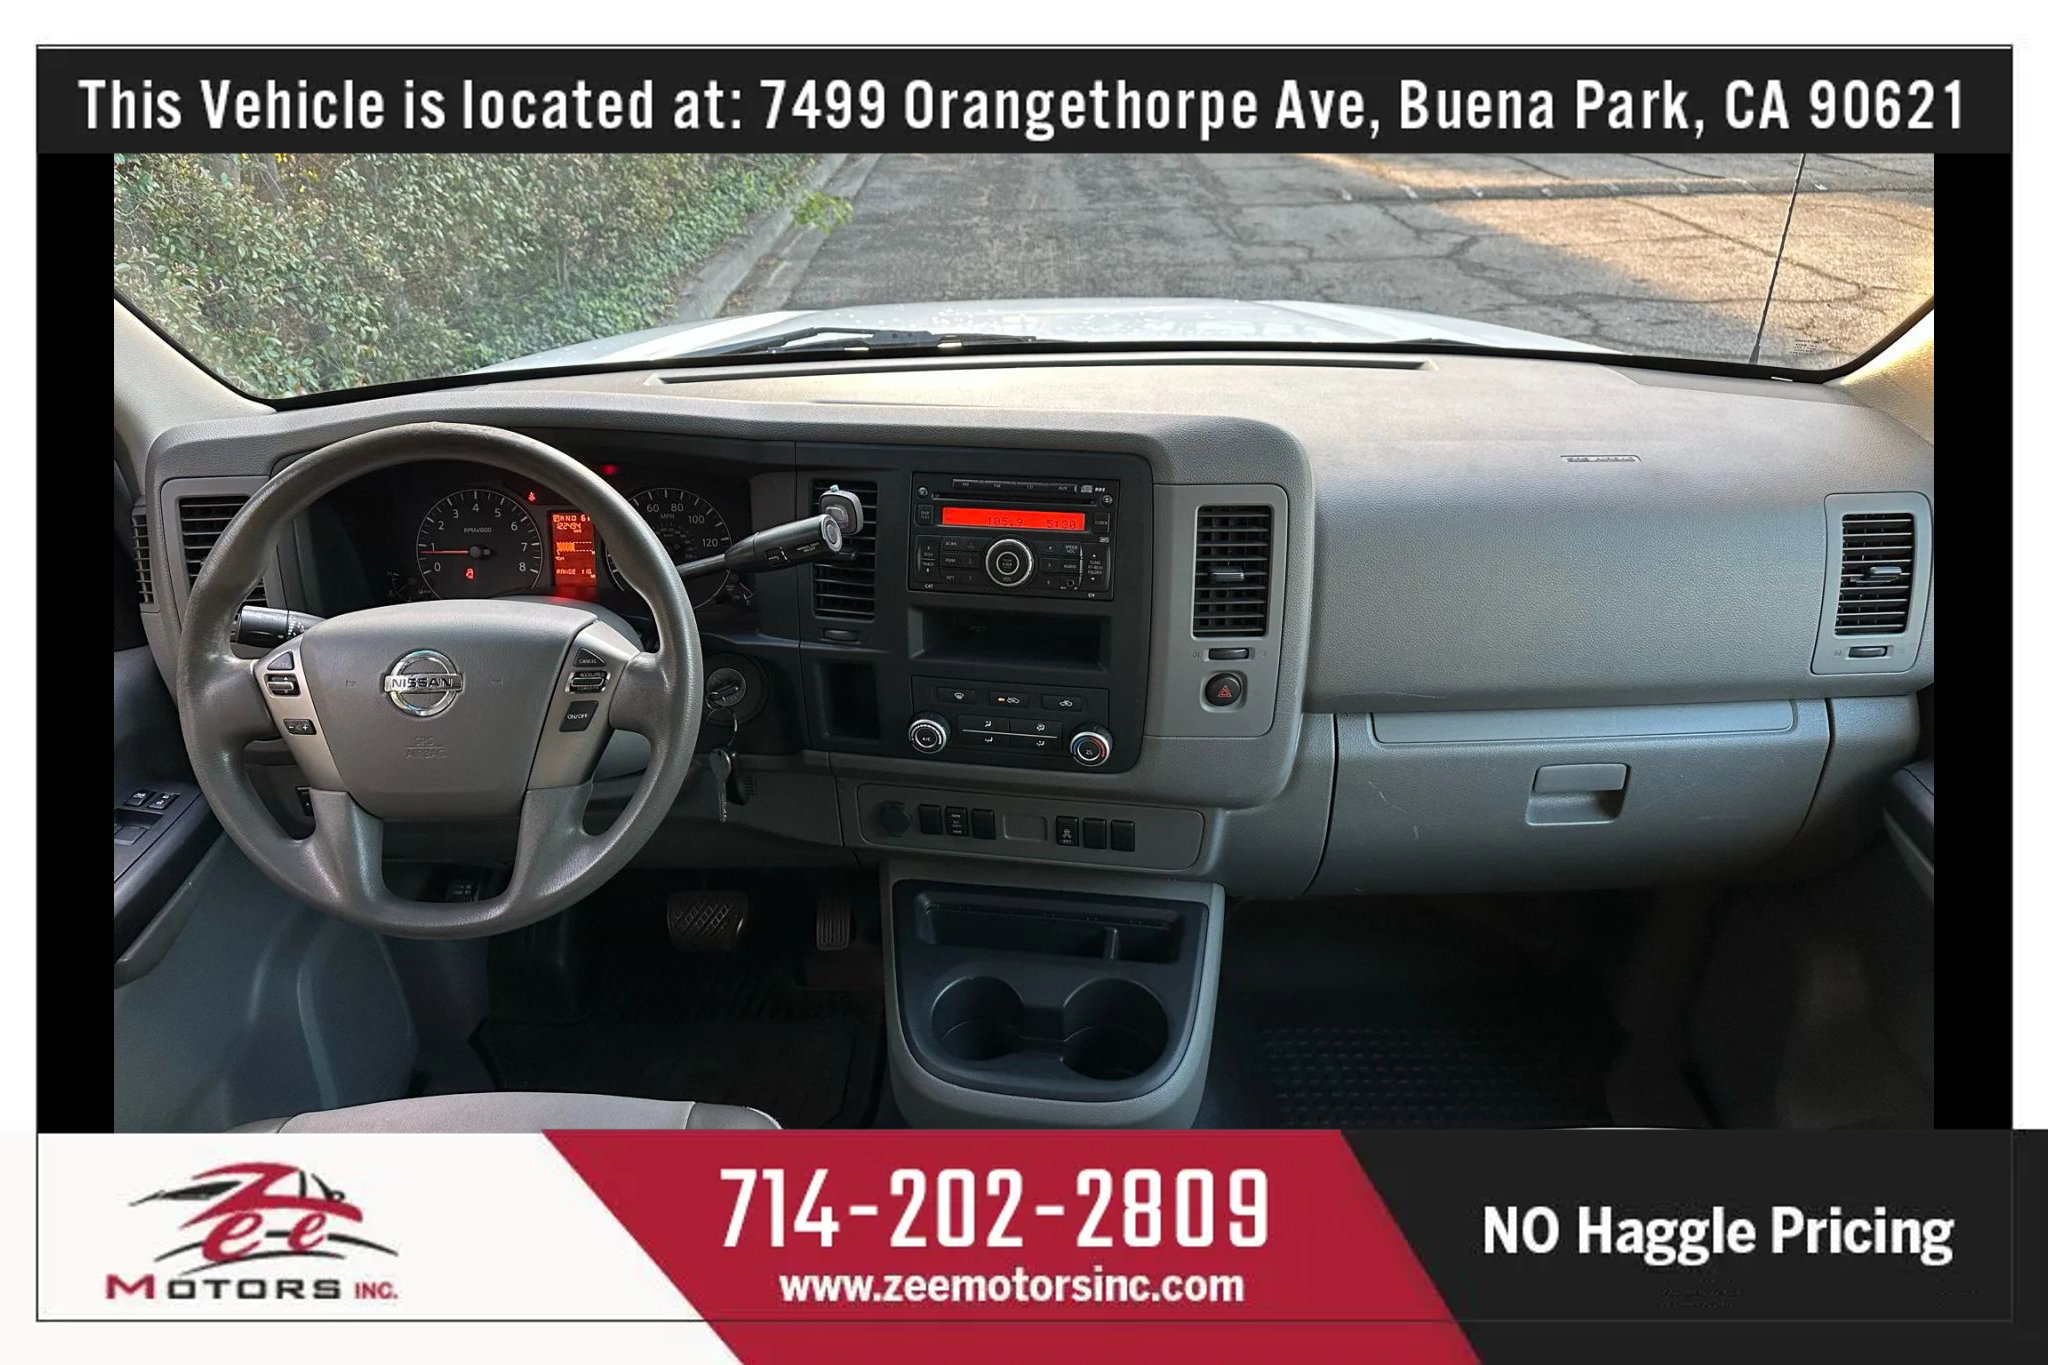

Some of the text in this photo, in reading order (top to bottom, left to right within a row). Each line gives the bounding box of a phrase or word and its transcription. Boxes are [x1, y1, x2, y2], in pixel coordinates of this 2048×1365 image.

[472, 503, 479, 512] 4
[646, 504, 660, 513] 60
[670, 503, 684, 512] 80
[452, 508, 459, 519] 3
[494, 508, 502, 518] 5
[688, 515, 705, 524] 100
[438, 520, 445, 530] 2
[510, 521, 519, 531] 6
[520, 542, 528, 552] 7
[702, 537, 719, 548] 120
[434, 562, 441, 572] 0
[519, 562, 527, 572] 8
[391, 678, 453, 689] NISSAN
